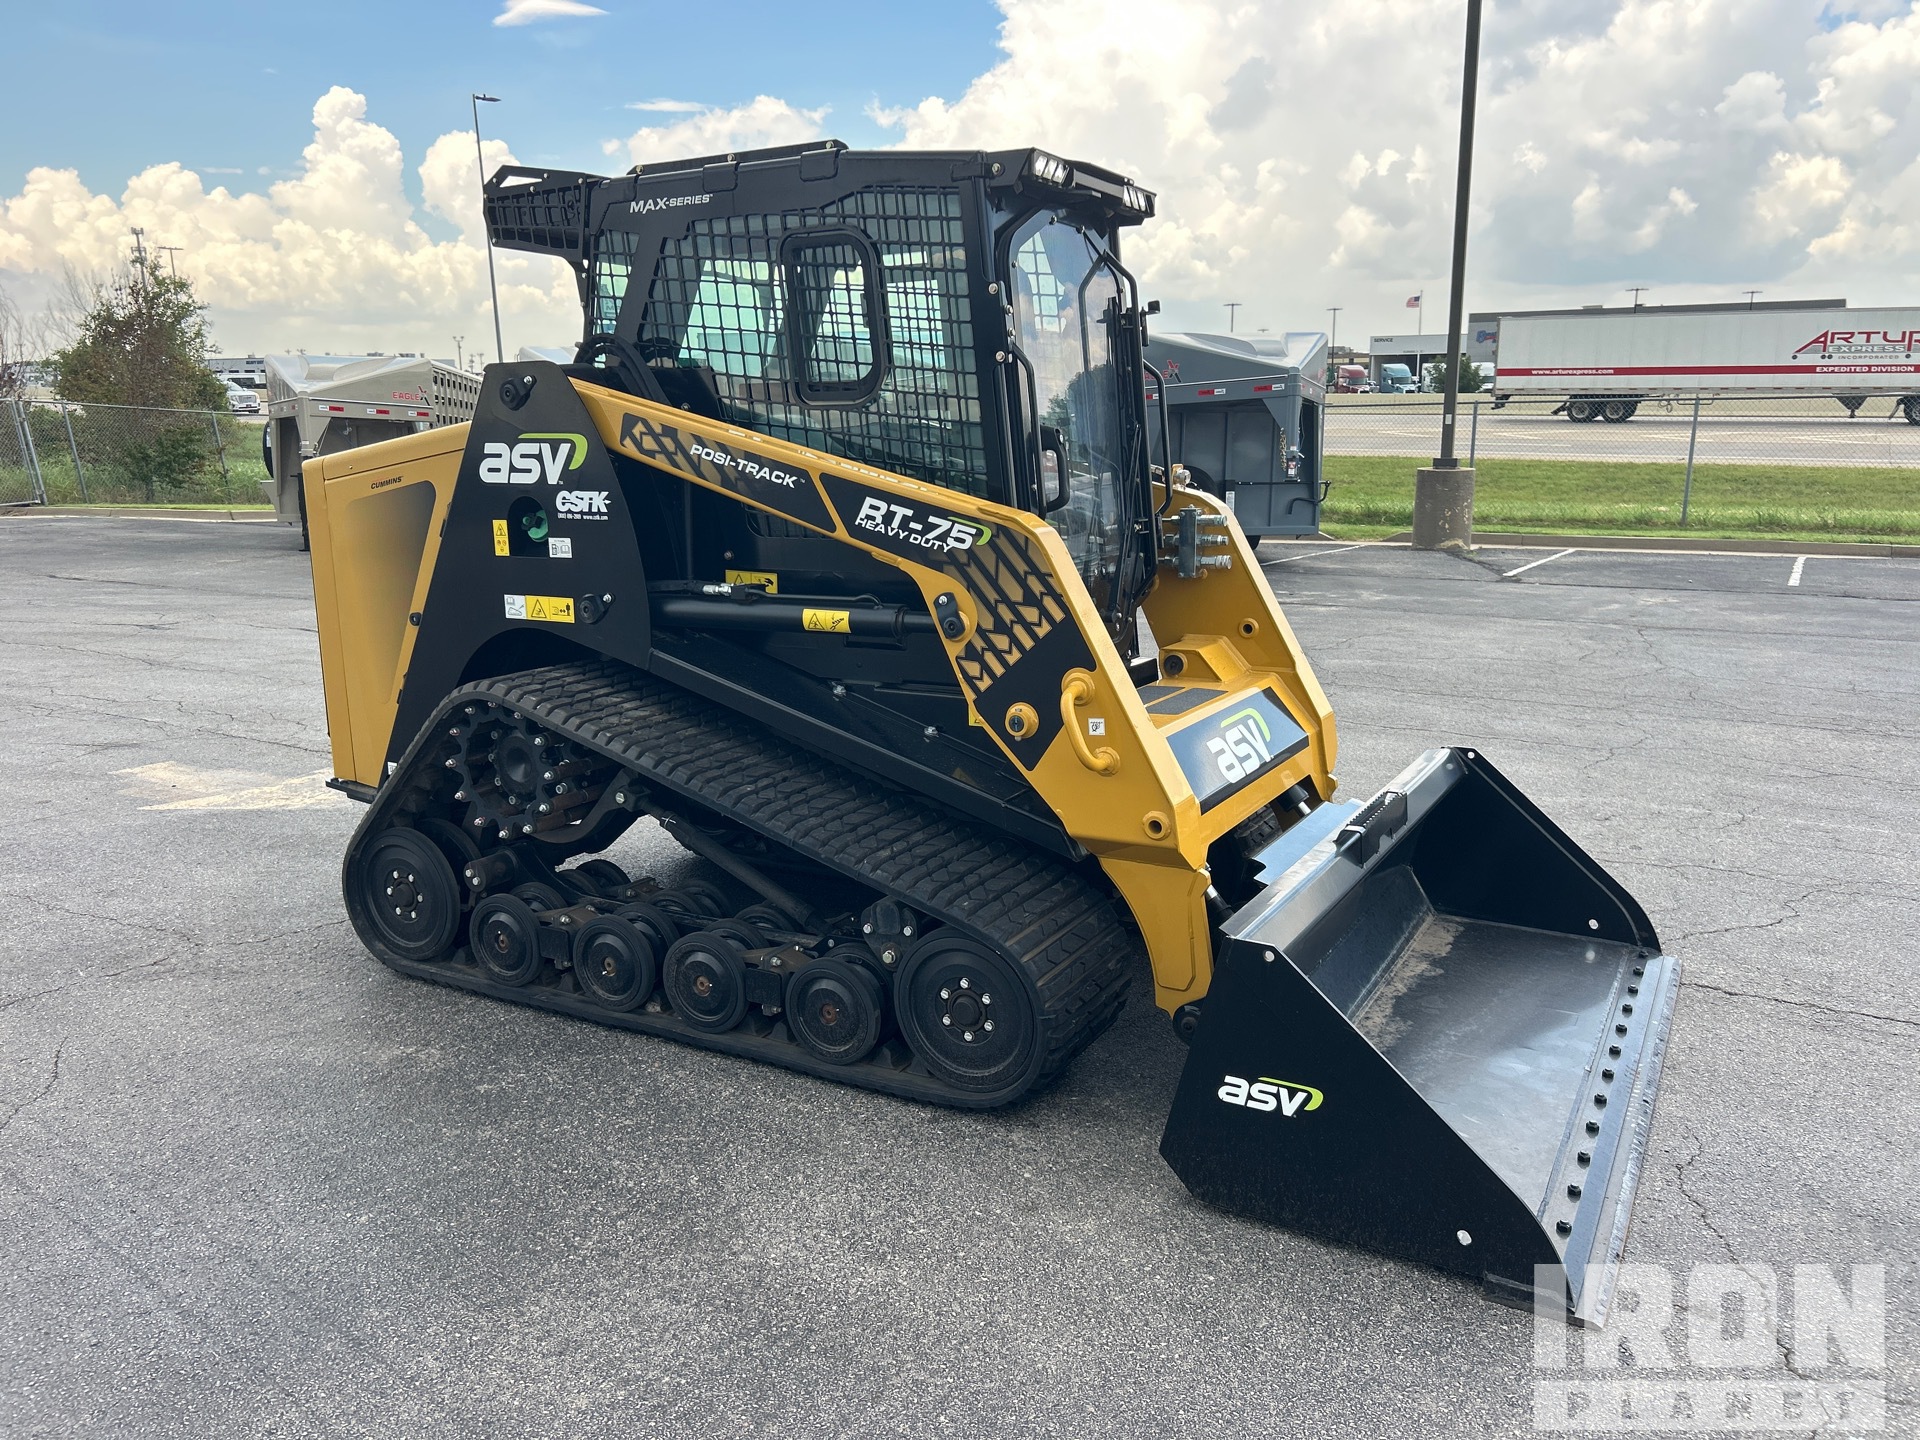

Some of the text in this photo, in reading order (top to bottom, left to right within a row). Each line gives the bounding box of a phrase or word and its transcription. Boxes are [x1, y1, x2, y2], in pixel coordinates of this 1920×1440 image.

[630, 194, 711, 214] MAX-SERIES
[1828, 345, 1905, 353] EXPRESS
[1531, 368, 1615, 376] www.arturexpress.com
[392, 391, 420, 401] EAGLE
[689, 444, 798, 489] POSI-TRACK
[370, 476, 402, 490] CUMMINS
[858, 496, 977, 550] RT-75
[855, 519, 955, 553] HEAVY DUTY
